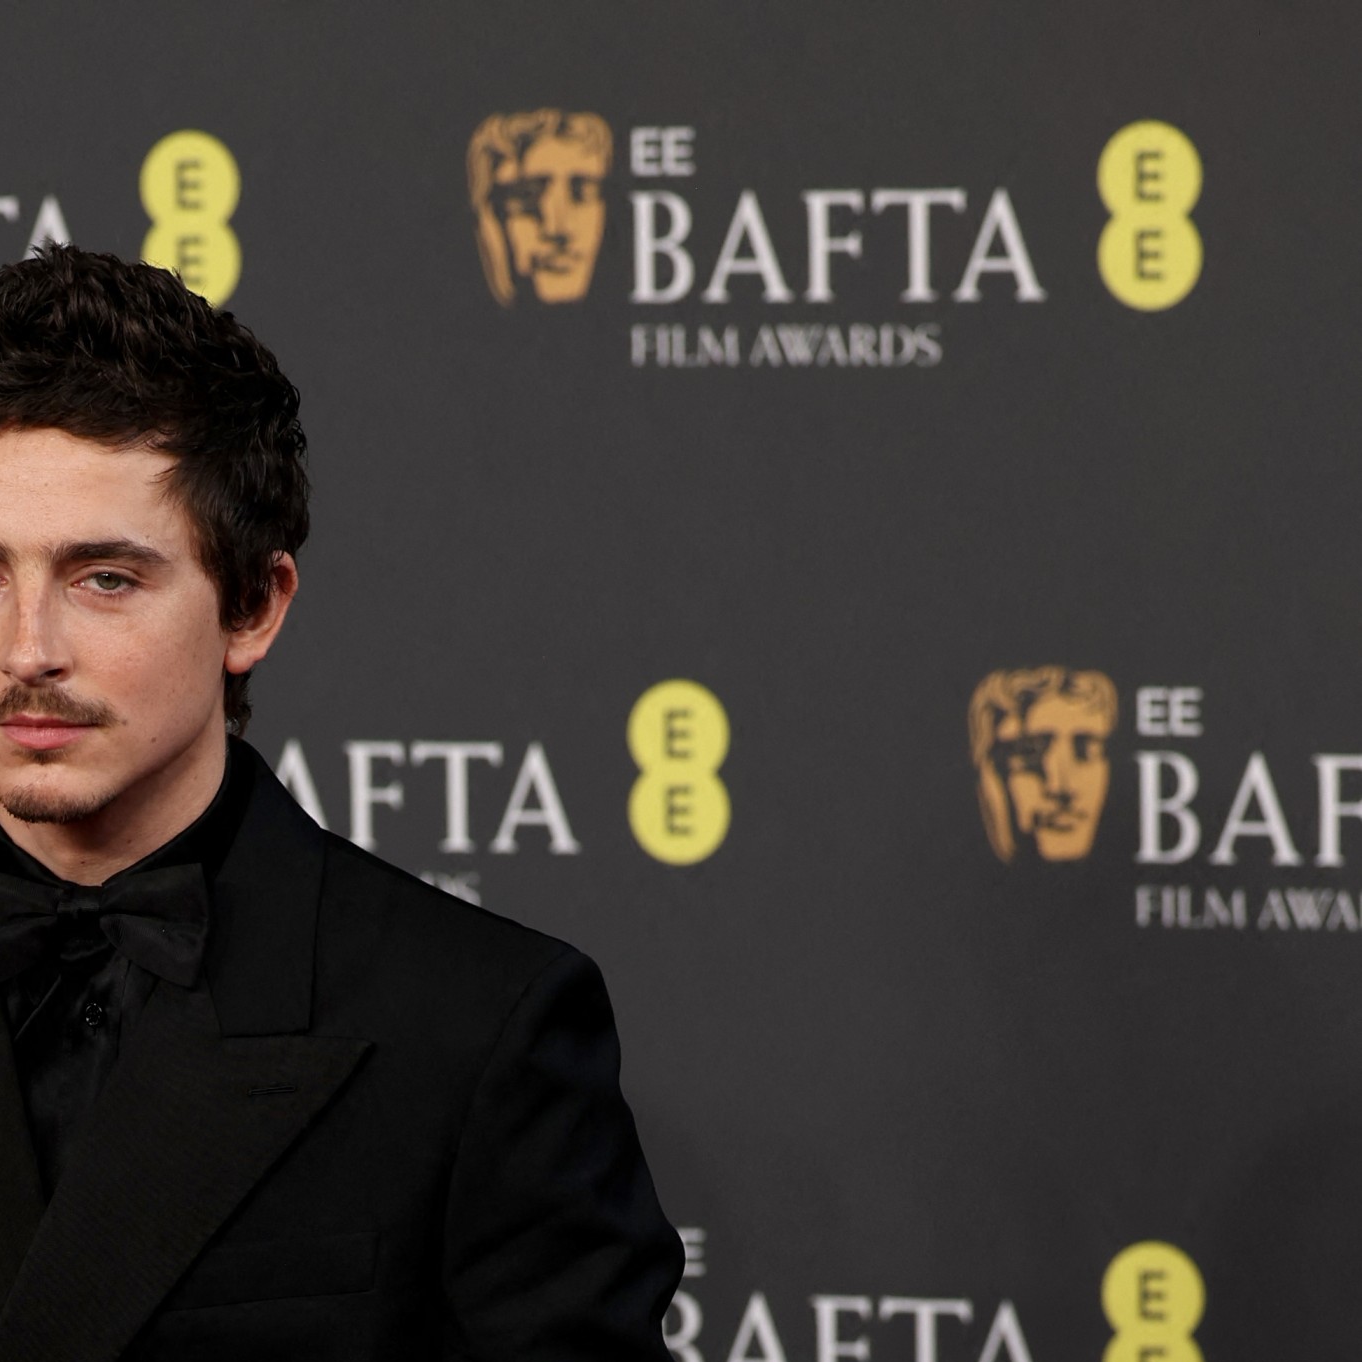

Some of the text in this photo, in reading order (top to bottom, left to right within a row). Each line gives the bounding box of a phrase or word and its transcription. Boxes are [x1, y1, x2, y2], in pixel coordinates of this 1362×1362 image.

[629, 126, 695, 177] EE
[630, 188, 1045, 304] BAFTA
[629, 323, 943, 367] FILM AWARDS
[1135, 686, 1203, 737] EE
[274, 741, 579, 854] AFTA
[1134, 885, 1362, 931] FILM AWA
